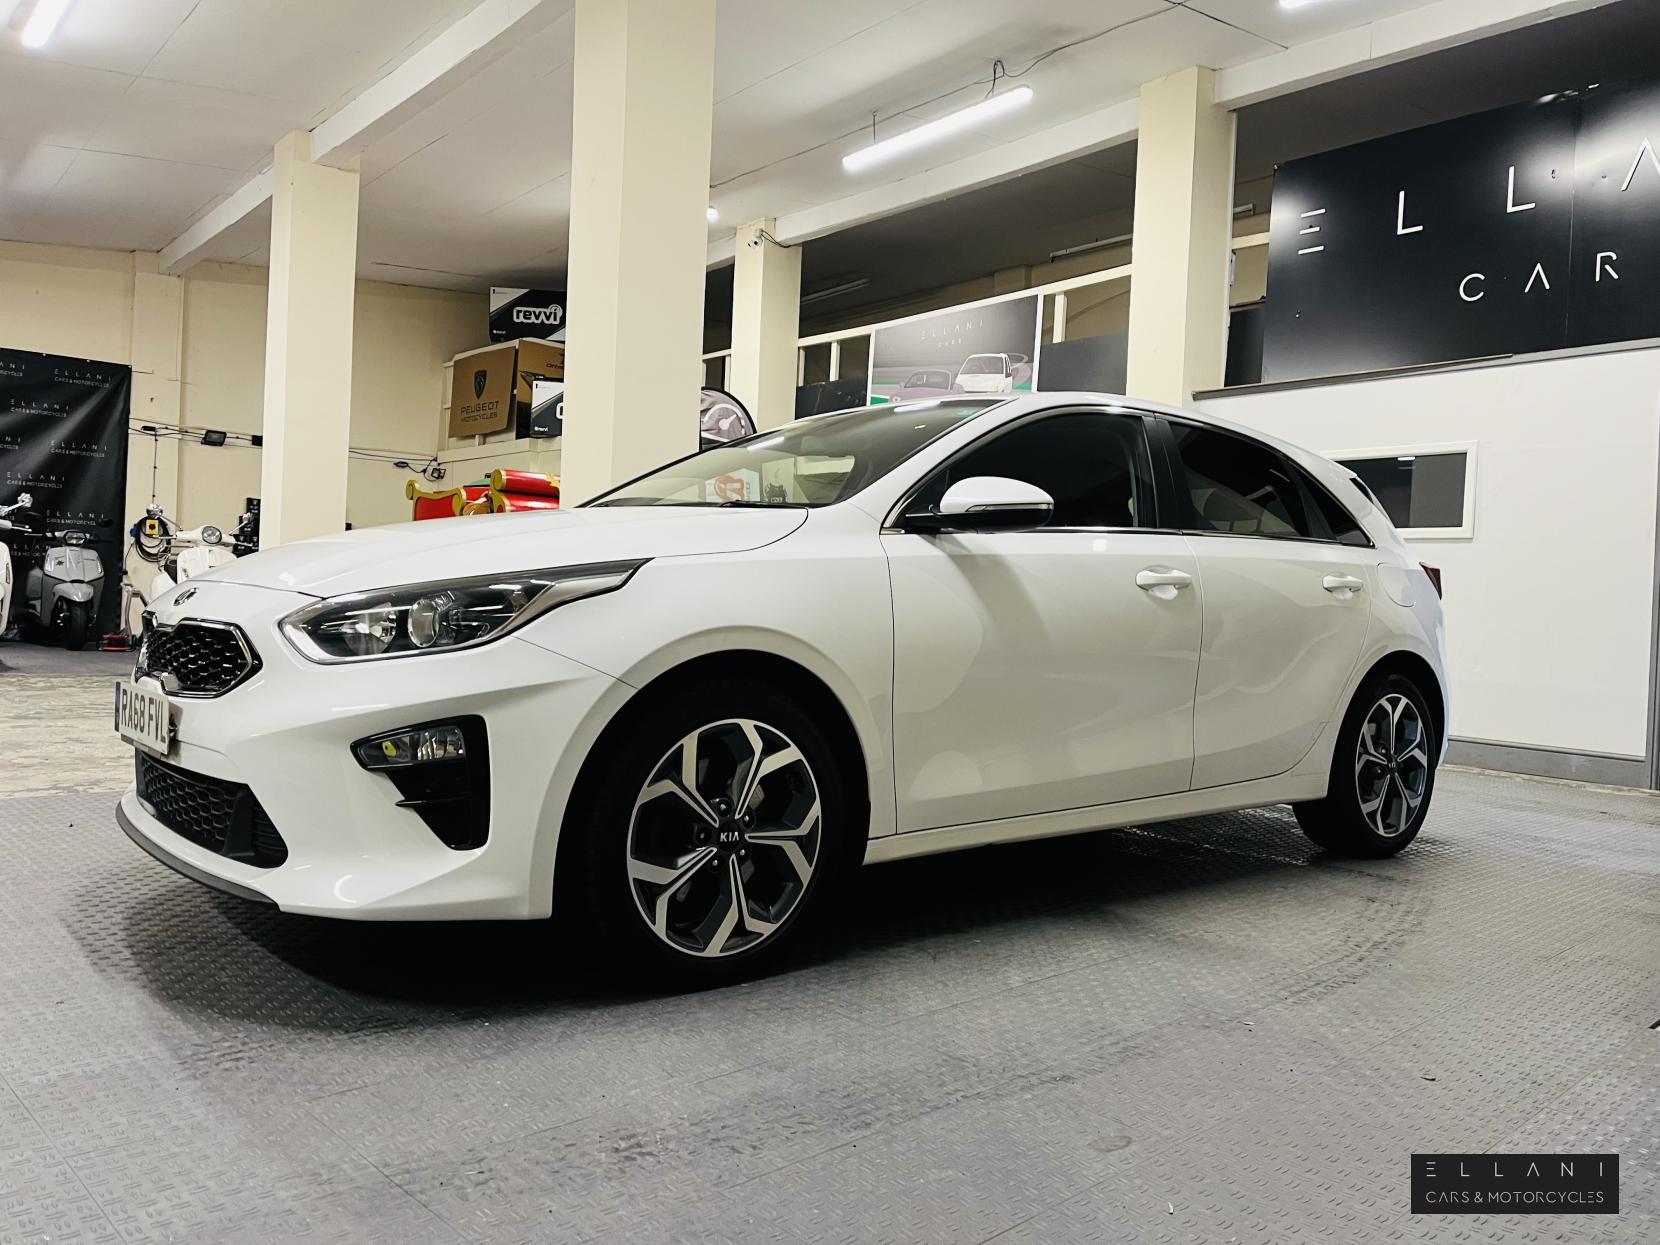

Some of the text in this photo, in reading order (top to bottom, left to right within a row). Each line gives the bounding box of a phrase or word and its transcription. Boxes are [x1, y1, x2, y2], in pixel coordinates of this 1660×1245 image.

[516, 305, 558, 322] revvi
[54, 368, 112, 382] ELLANI
[10, 398, 69, 411] ELLANI
[460, 400, 499, 416] PEUGEOT
[50, 440, 107, 451] ELLANI
[7, 471, 65, 482] ELLANI
[122, 689, 145, 733] RA68
[720, 831, 739, 842] KIA
